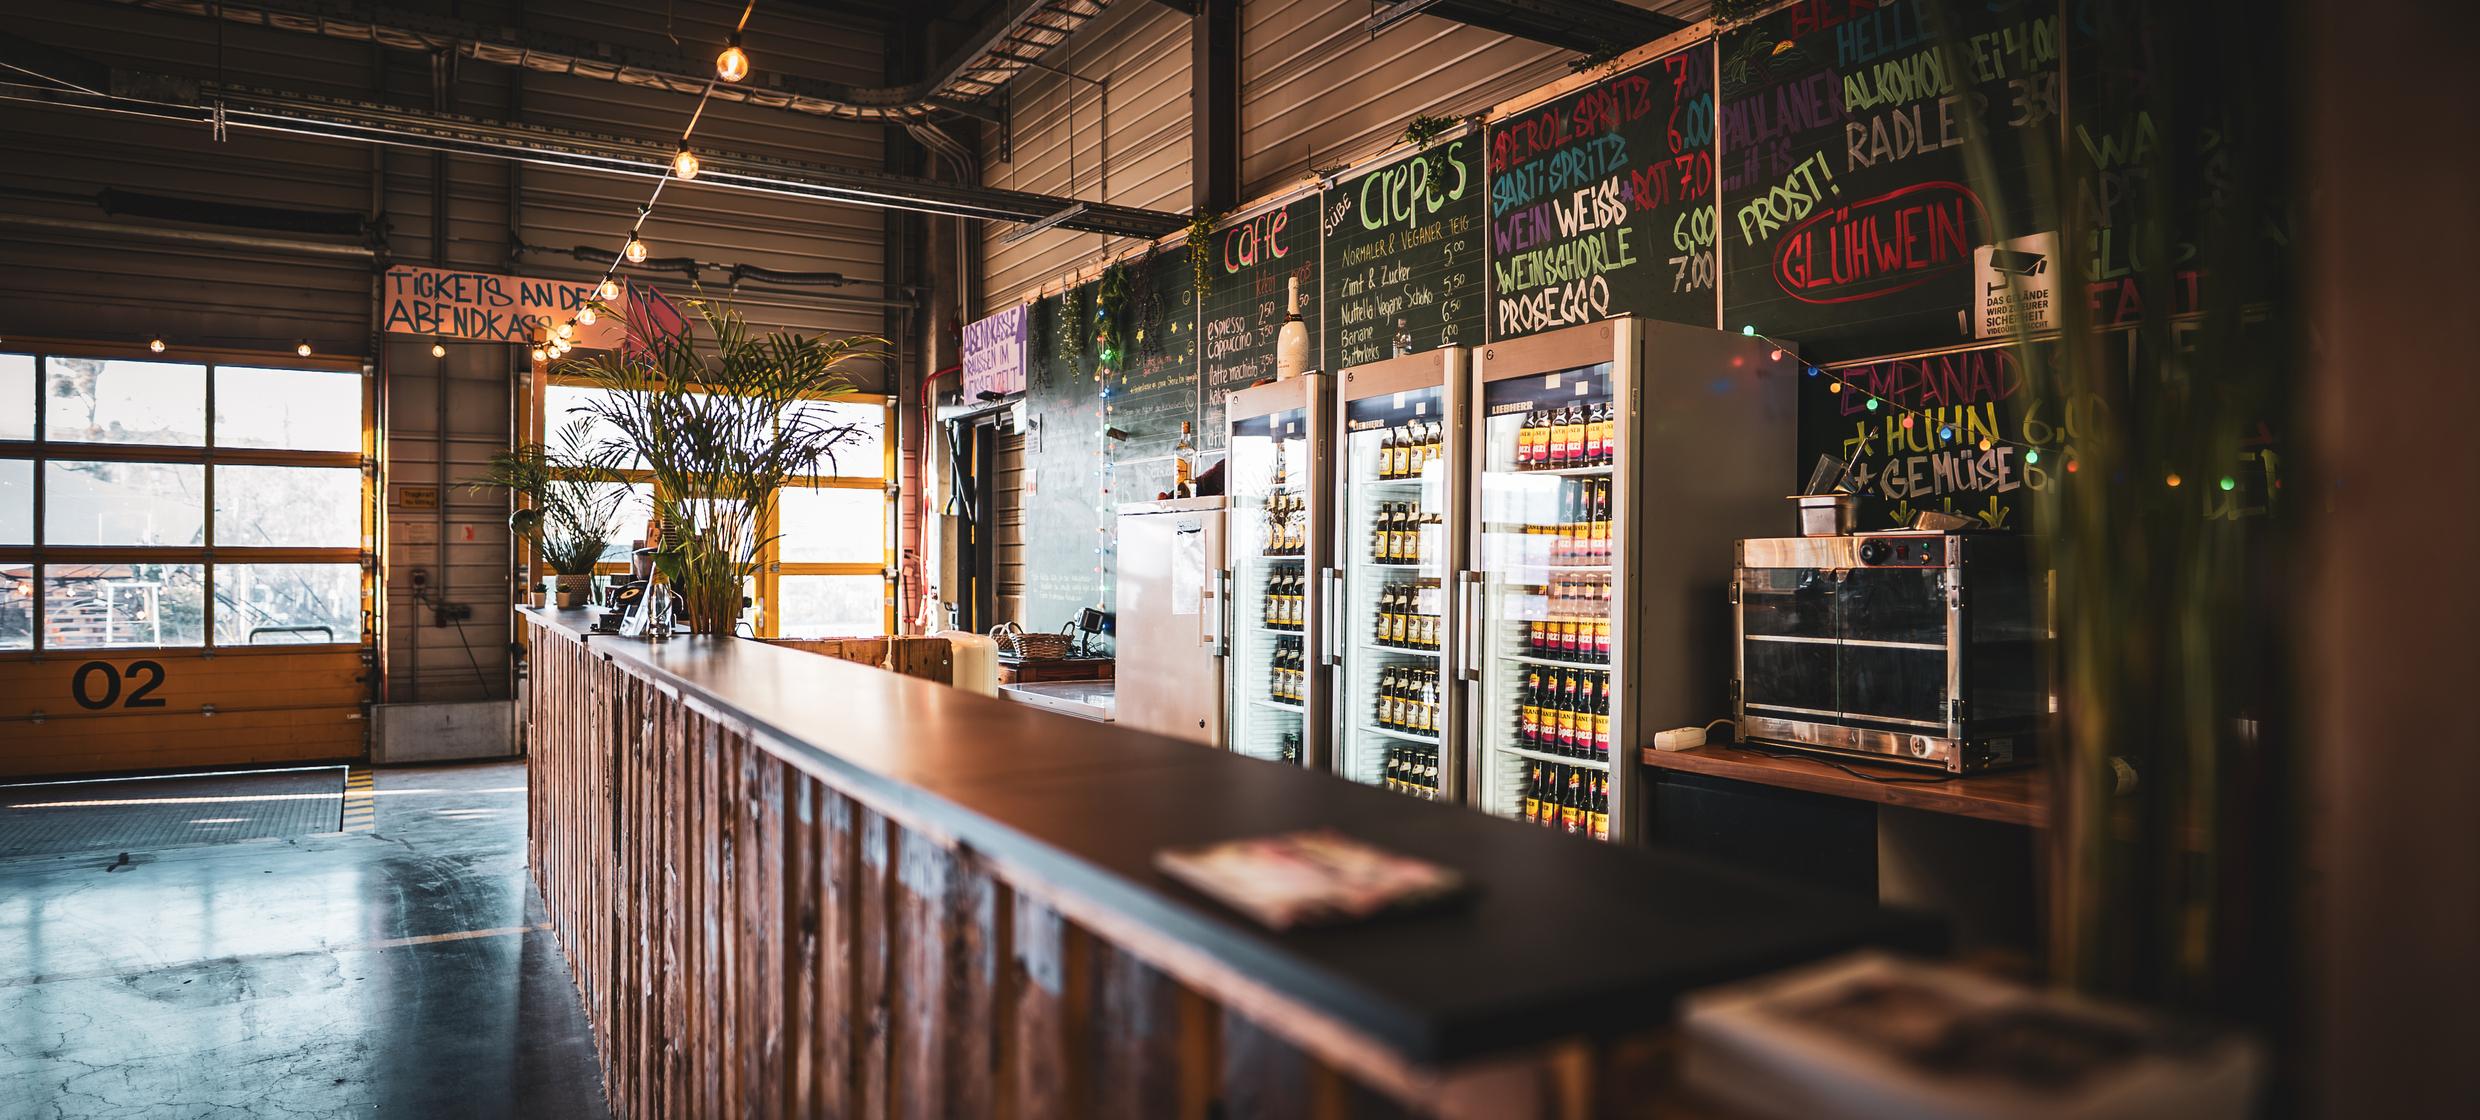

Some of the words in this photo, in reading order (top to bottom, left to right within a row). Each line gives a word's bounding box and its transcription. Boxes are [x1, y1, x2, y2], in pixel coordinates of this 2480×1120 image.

[1721, 67, 1855, 157] PAULANER
[1490, 107, 1572, 174] APEROL
[1631, 159, 1672, 212] ROT
[1738, 150, 1840, 247] PROST!
[1400, 221, 1443, 249] VEGANER
[1450, 213, 1469, 234] TEIG
[1673, 205, 1717, 256] 6,00
[1783, 198, 1968, 289] GLÜHWEIN
[521, 281, 553, 308] AN
[1341, 273, 1364, 298] Zimt
[1368, 266, 1376, 290] &
[1381, 260, 1410, 288] Zucker
[1404, 283, 1433, 308] Schoko
[1500, 274, 1610, 336] PROSECCO
[1987, 296, 2004, 307] DAS
[1987, 306, 2008, 316] WIRD
[1207, 316, 1246, 341] espresso
[1341, 326, 1373, 348] Banane
[1341, 343, 1380, 368] Butterkeks
[1209, 363, 1229, 387] latte
[1491, 401, 1534, 415] LIEBHERR
[1880, 446, 2021, 499] GEMÜSE
[72, 660, 167, 710] 02
